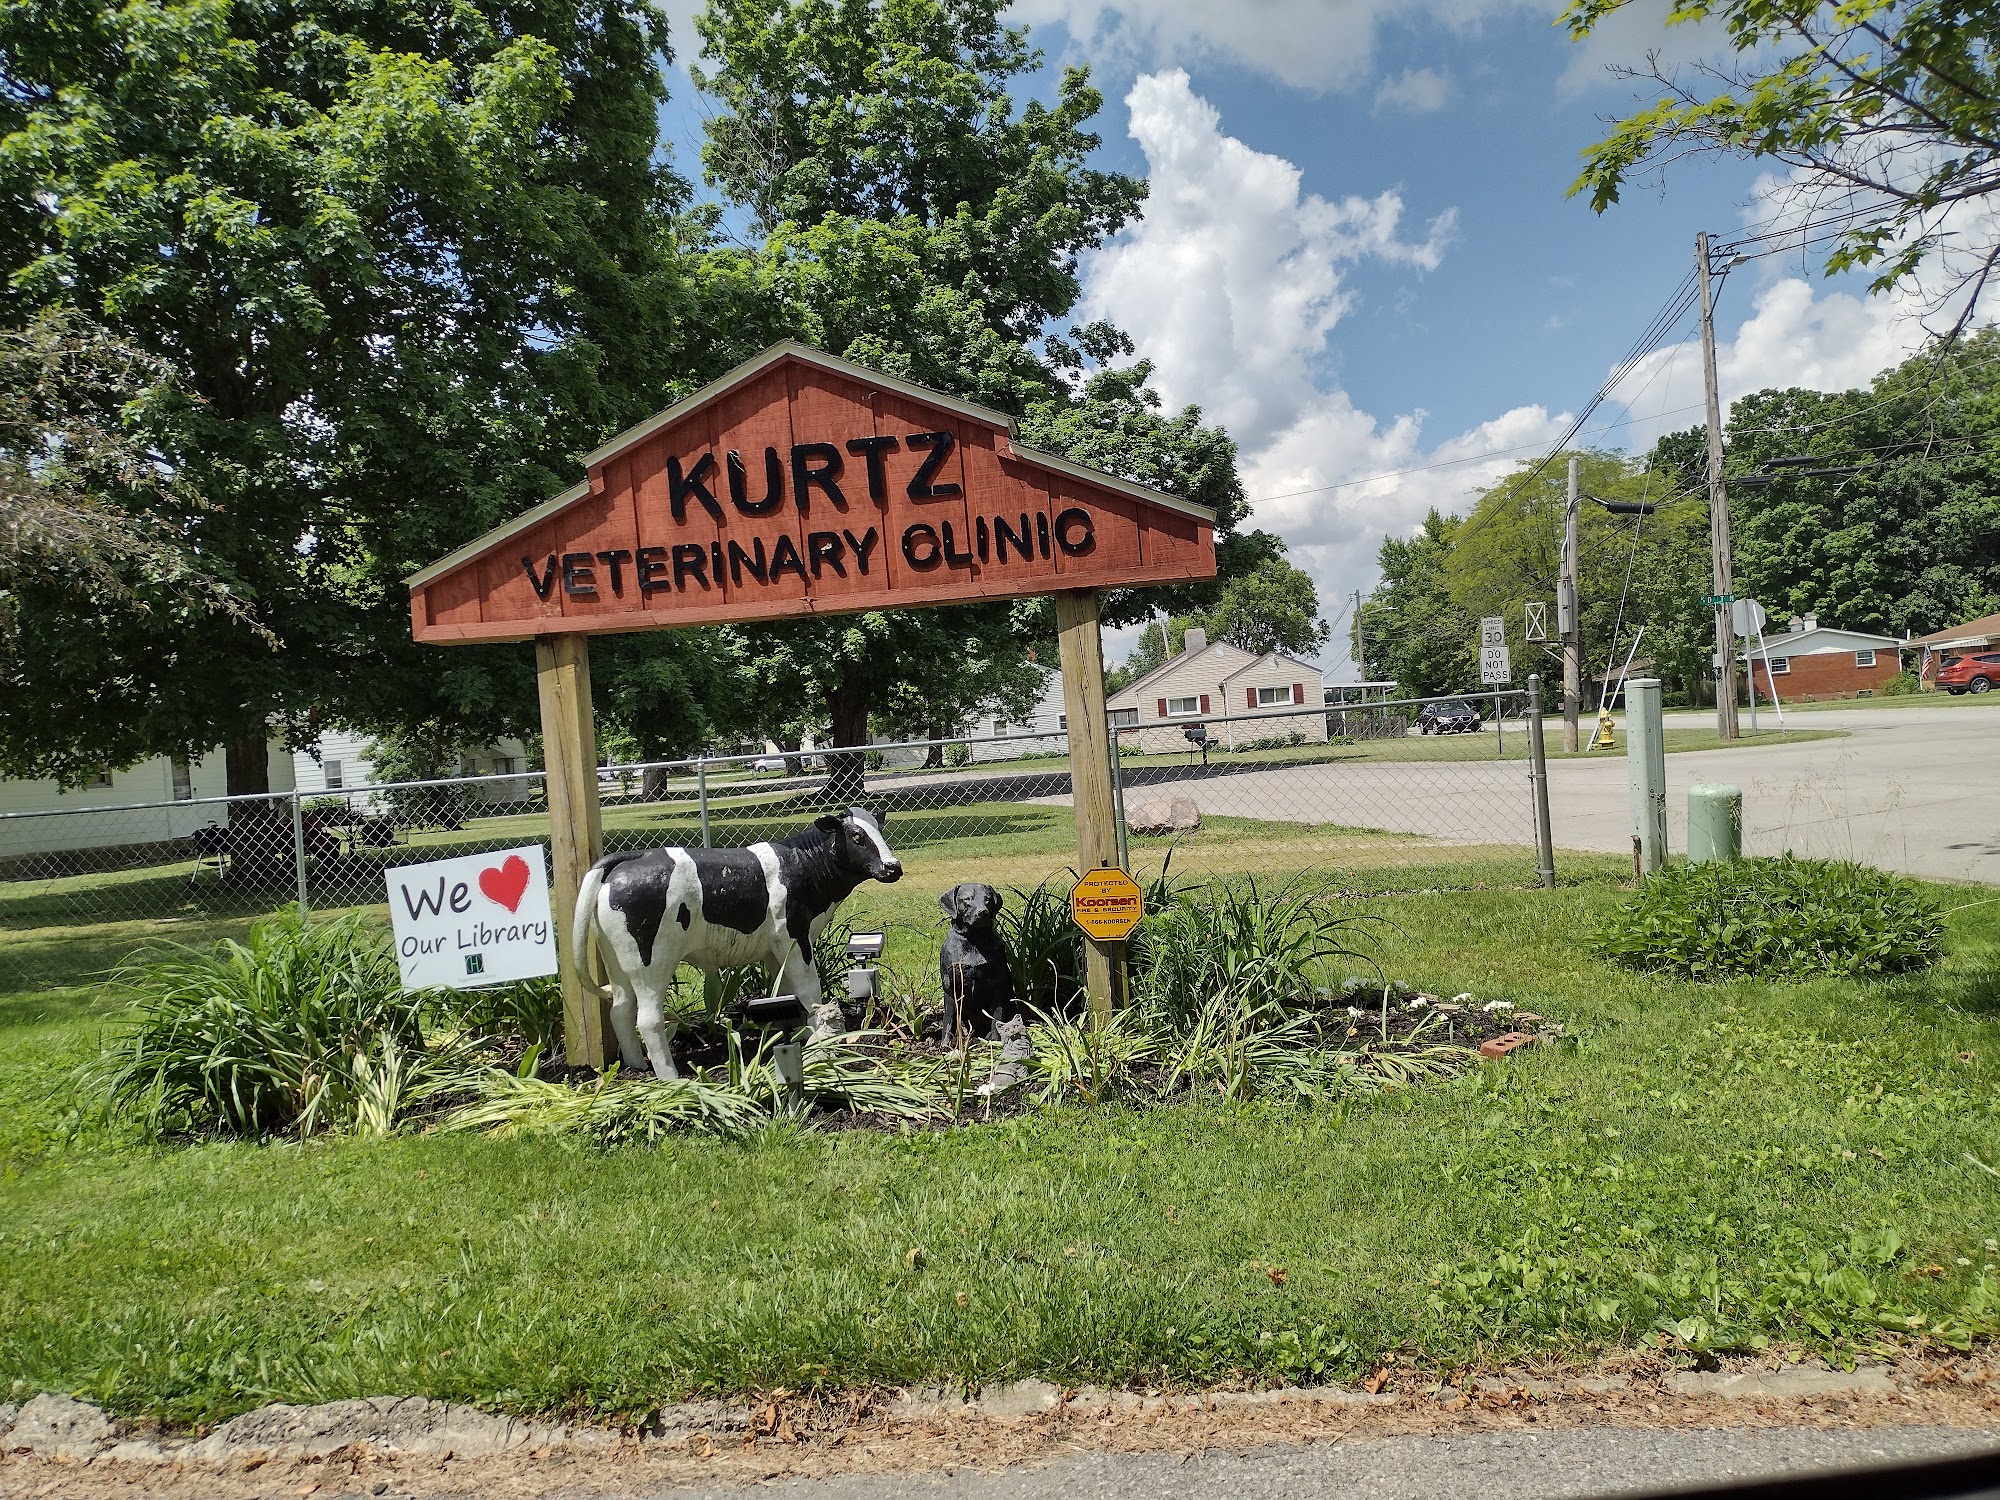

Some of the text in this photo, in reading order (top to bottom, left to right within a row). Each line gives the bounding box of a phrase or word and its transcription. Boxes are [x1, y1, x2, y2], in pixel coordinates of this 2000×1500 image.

[667, 431, 962, 520] KURTZ
[521, 508, 1096, 601] VETERINARY CLINIC
[1485, 631, 1502, 643] 30
[1488, 650, 1501, 659] DO
[1485, 660, 1504, 670] NOT
[1483, 671, 1508, 680] PASS
[401, 876, 472, 921] We
[1075, 896, 1137, 907] Koorsen
[401, 920, 547, 957] Our Library
